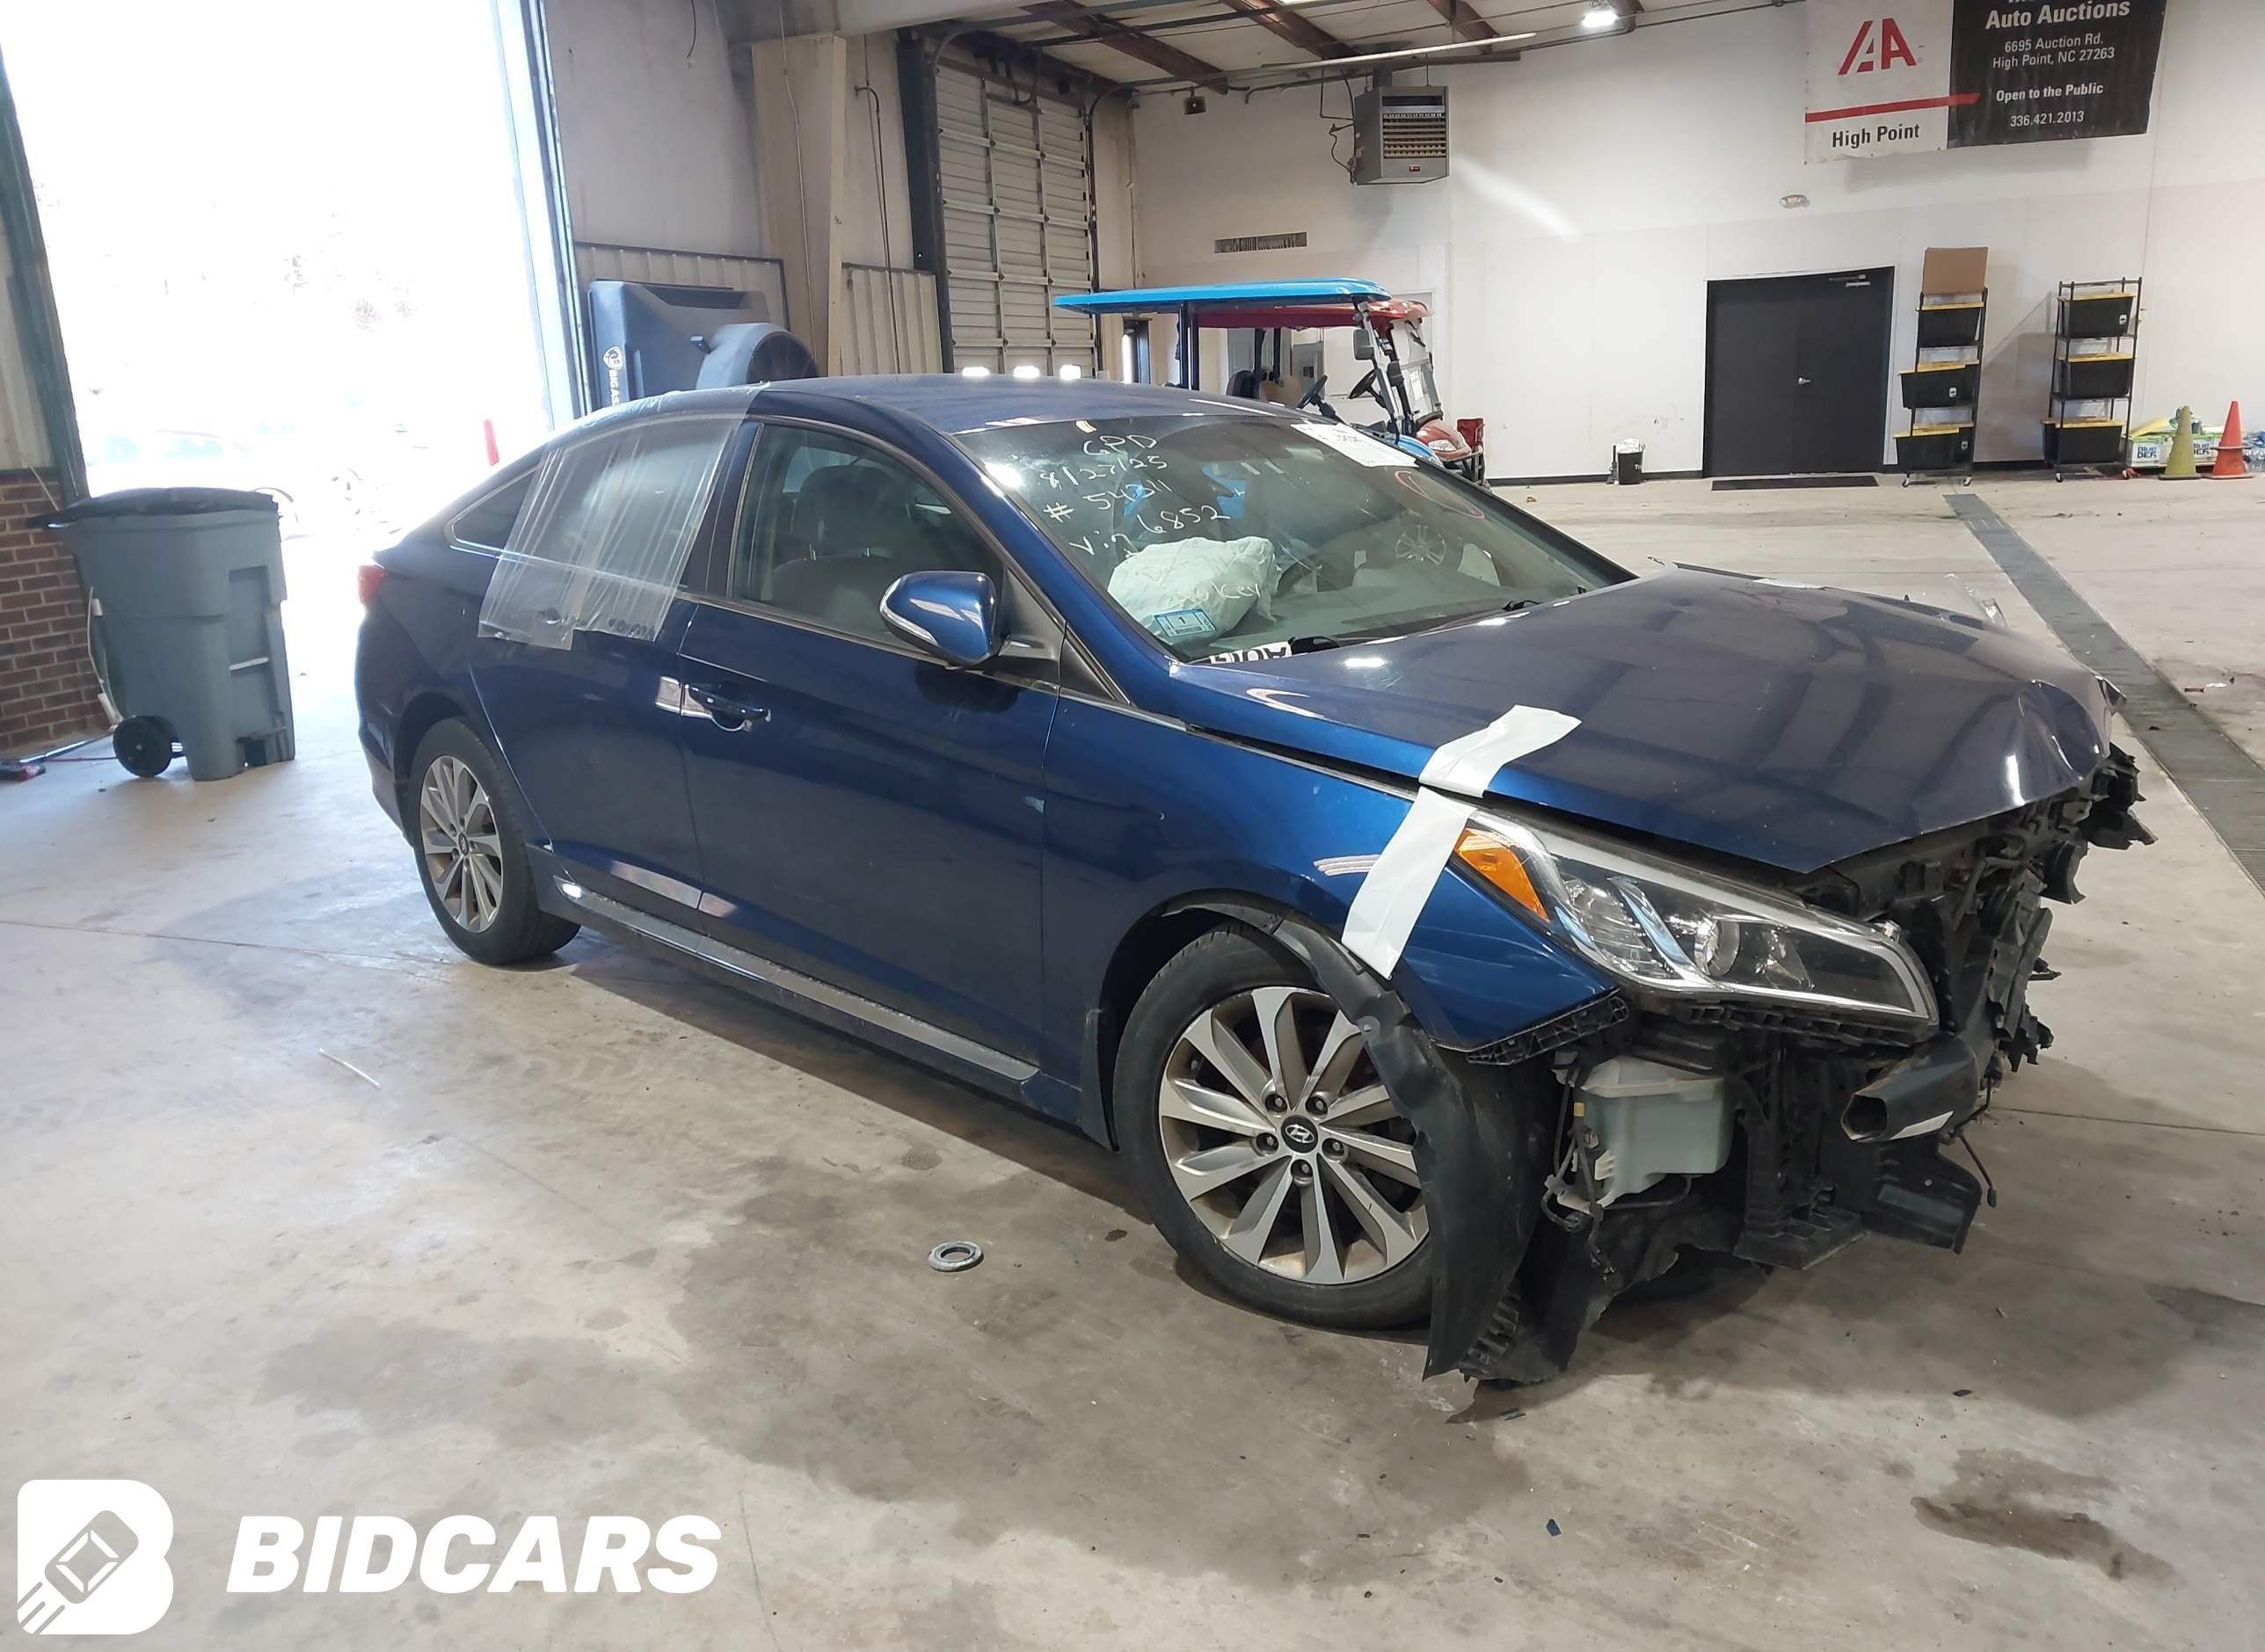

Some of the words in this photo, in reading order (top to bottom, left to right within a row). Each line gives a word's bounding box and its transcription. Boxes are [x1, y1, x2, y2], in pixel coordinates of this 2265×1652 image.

[1985, 10, 2031, 30] Auto
[2036, 1, 2130, 25] Auctions
[2005, 39, 2032, 53] 6695
[2035, 35, 2081, 50] Auction
[2085, 32, 2104, 46] Rd.
[1992, 56, 2019, 71] High
[2021, 54, 2054, 66] Point,
[2057, 49, 2076, 64] NC
[2079, 47, 2115, 62] 27263
[1996, 90, 2026, 104] Open
[2028, 89, 2040, 99] to
[2043, 85, 2062, 98] the
[2065, 82, 2104, 96] Public
[2009, 110, 2085, 127] 336.421.2013
[1832, 127, 1871, 149] High
[1876, 123, 1920, 142] Point
